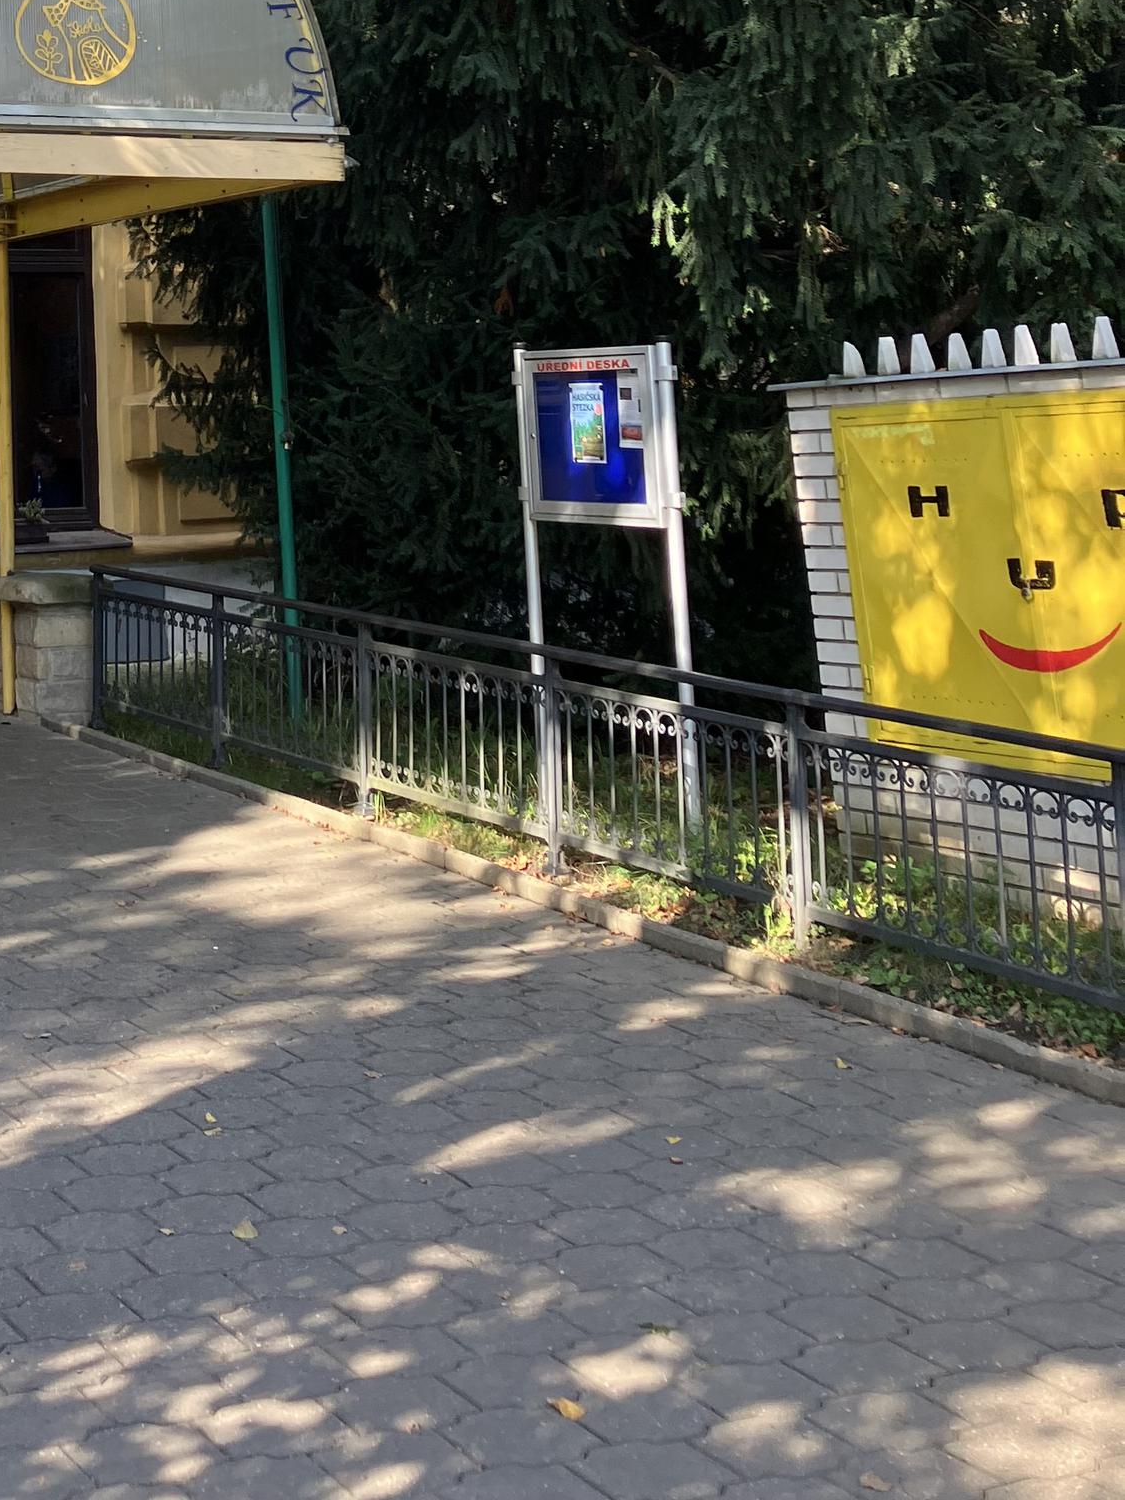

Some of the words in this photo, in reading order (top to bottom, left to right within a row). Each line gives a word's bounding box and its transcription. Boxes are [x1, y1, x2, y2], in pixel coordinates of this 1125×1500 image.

[285, 37, 328, 122] UK
[586, 358, 630, 370] DESKA
[907, 485, 950, 518] H
